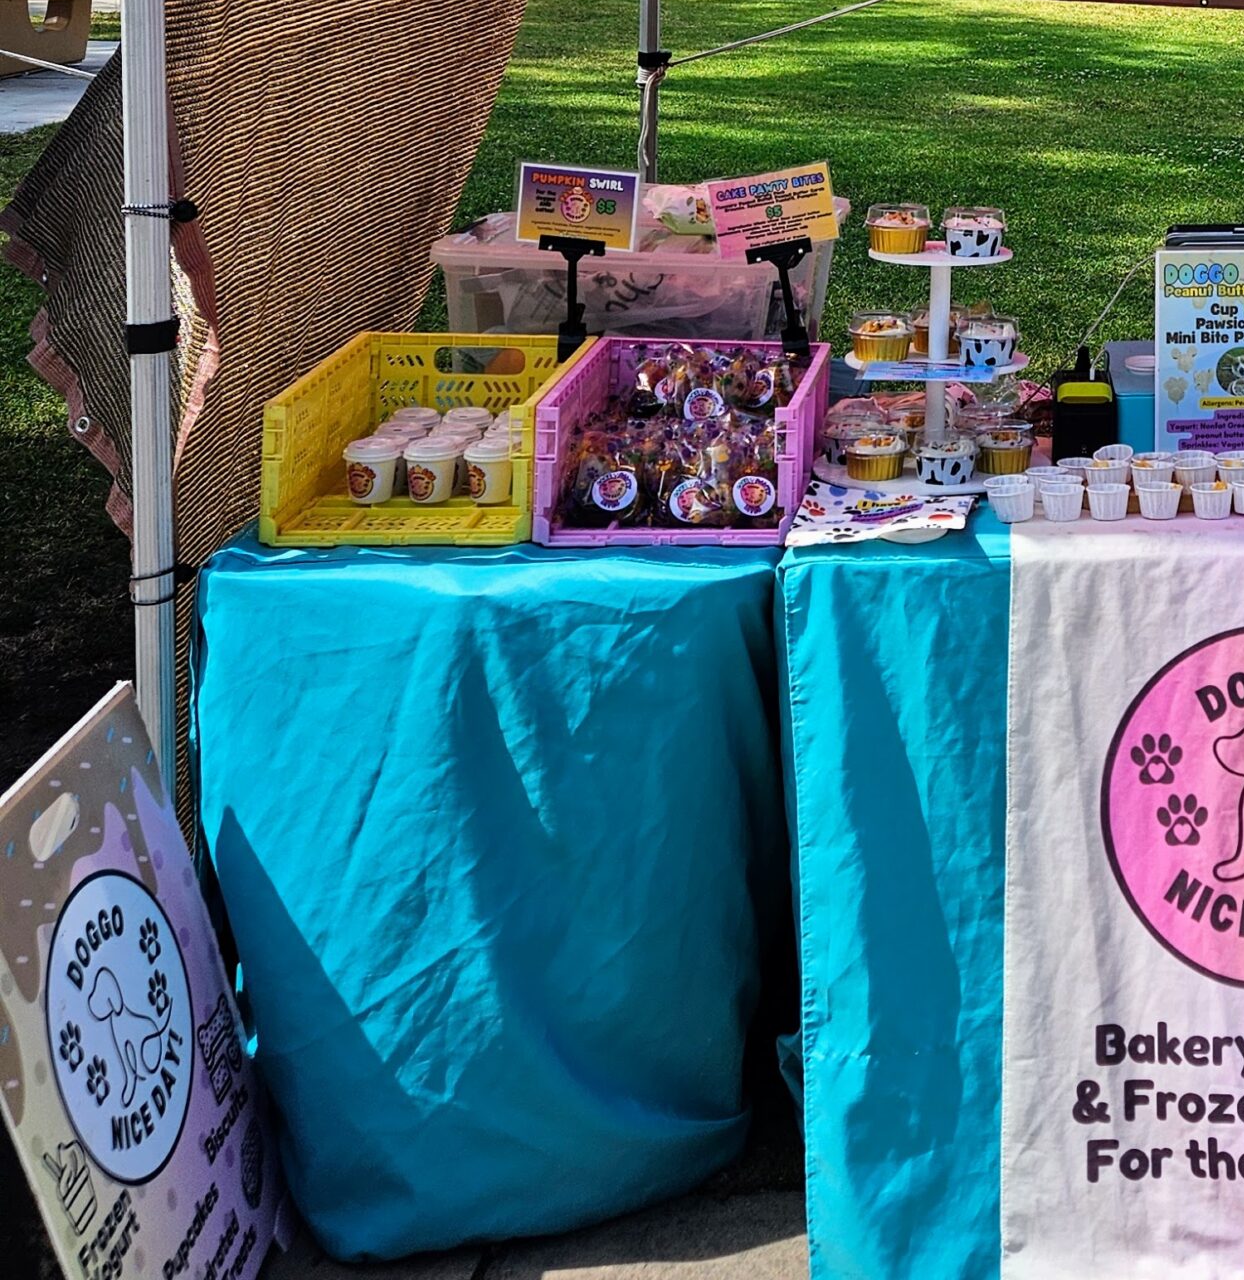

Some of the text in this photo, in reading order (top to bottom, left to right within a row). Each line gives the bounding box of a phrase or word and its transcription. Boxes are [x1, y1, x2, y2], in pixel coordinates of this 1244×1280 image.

[531, 172, 624, 192] PUMPKIN SWIRL
[716, 172, 824, 201] CAKE PAWTY BITES
[596, 198, 616, 215] $5
[765, 205, 783, 219] $5
[1164, 263, 1239, 285] DOGGO
[1164, 284, 1213, 297] Peanut
[1211, 303, 1238, 317] Cup
[1166, 331, 1195, 344] Mini
[1200, 331, 1229, 343] Bite
[67, 904, 125, 991] DOGGO
[110, 1029, 185, 1151] NICE DAY!
[1072, 1080, 1111, 1124] &
[205, 1085, 249, 1165] Biscuits
[1086, 1139, 1172, 1184] For
